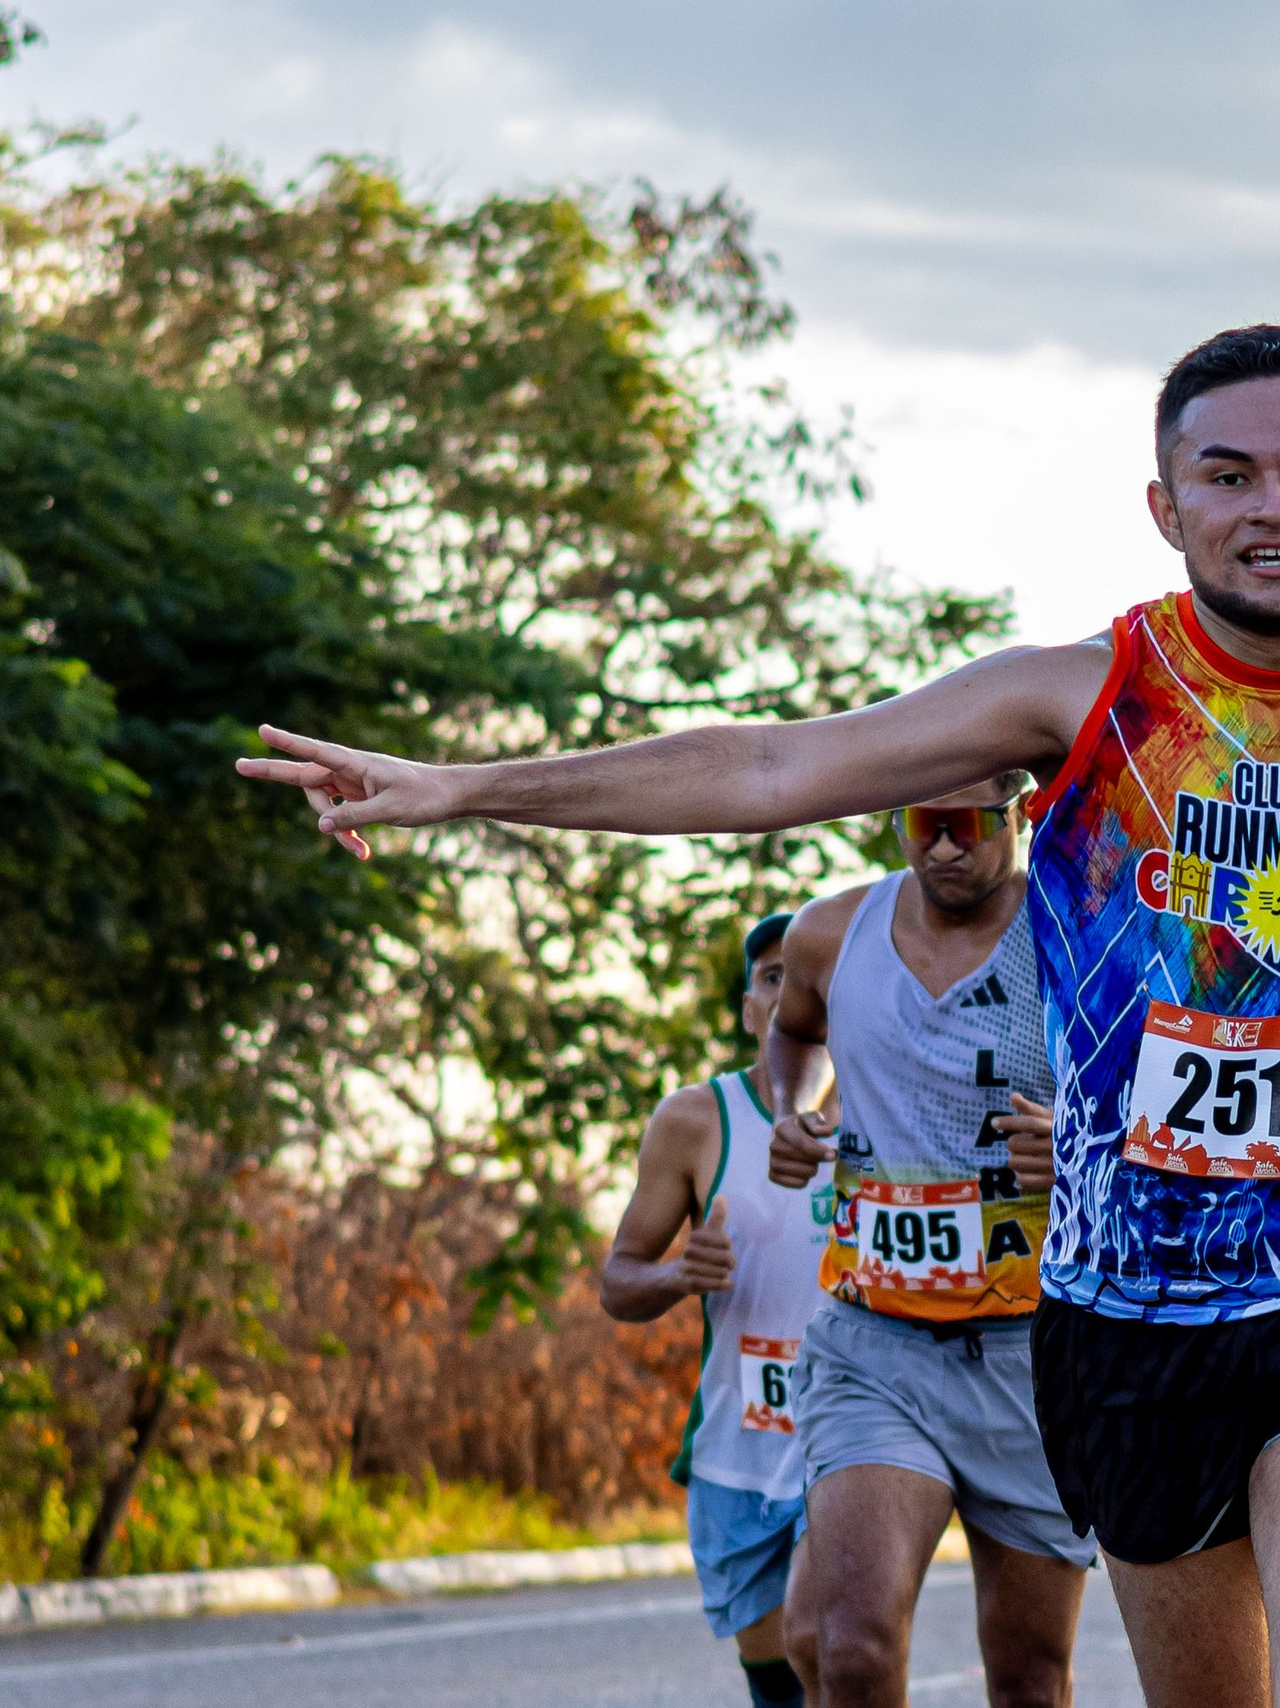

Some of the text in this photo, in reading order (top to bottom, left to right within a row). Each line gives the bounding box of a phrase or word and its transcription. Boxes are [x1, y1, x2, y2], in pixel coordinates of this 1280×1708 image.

[1167, 1153, 1183, 1162] Safe
[1210, 1158, 1228, 1167] Safe
[1255, 1160, 1274, 1169] Safe
[873, 1209, 961, 1264] 495
[762, 1363, 794, 1409] 6
